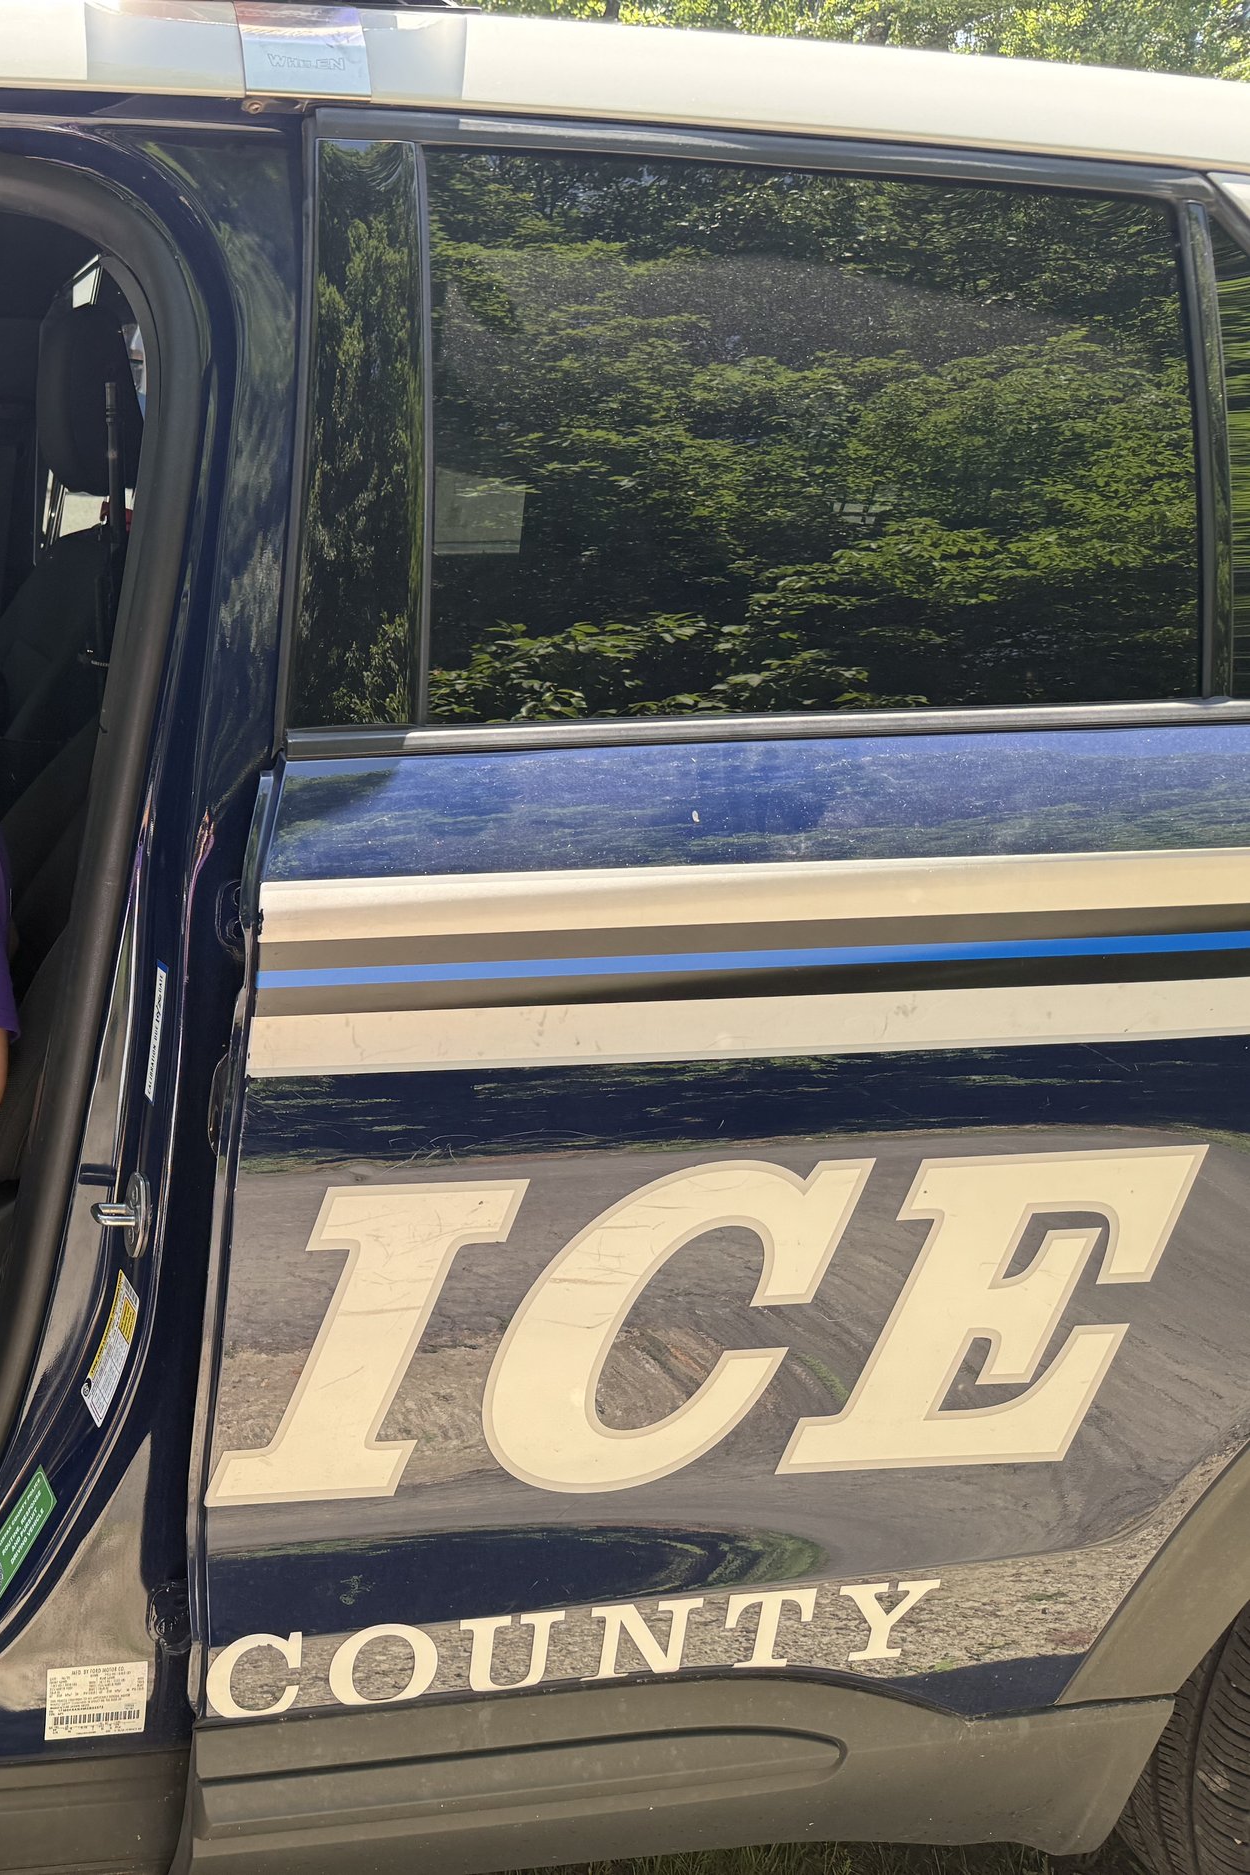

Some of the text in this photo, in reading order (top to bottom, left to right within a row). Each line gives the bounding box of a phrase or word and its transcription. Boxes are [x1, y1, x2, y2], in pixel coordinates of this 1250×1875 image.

[267, 53, 345, 70] WHELEN
[147, 1045, 157, 1095] CALIBRATION
[203, 1145, 1210, 1507] ICE
[2, 1490, 42, 1556] ROUTINE, RESPONSE
[11, 1500, 27, 1527] COUNTY
[26, 1478, 41, 1502] POLICE
[11, 1507, 38, 1551] AND PURSUIT
[10, 1508, 44, 1565] DRIVING VEHICLE
[205, 1578, 941, 1719] COUNTY
